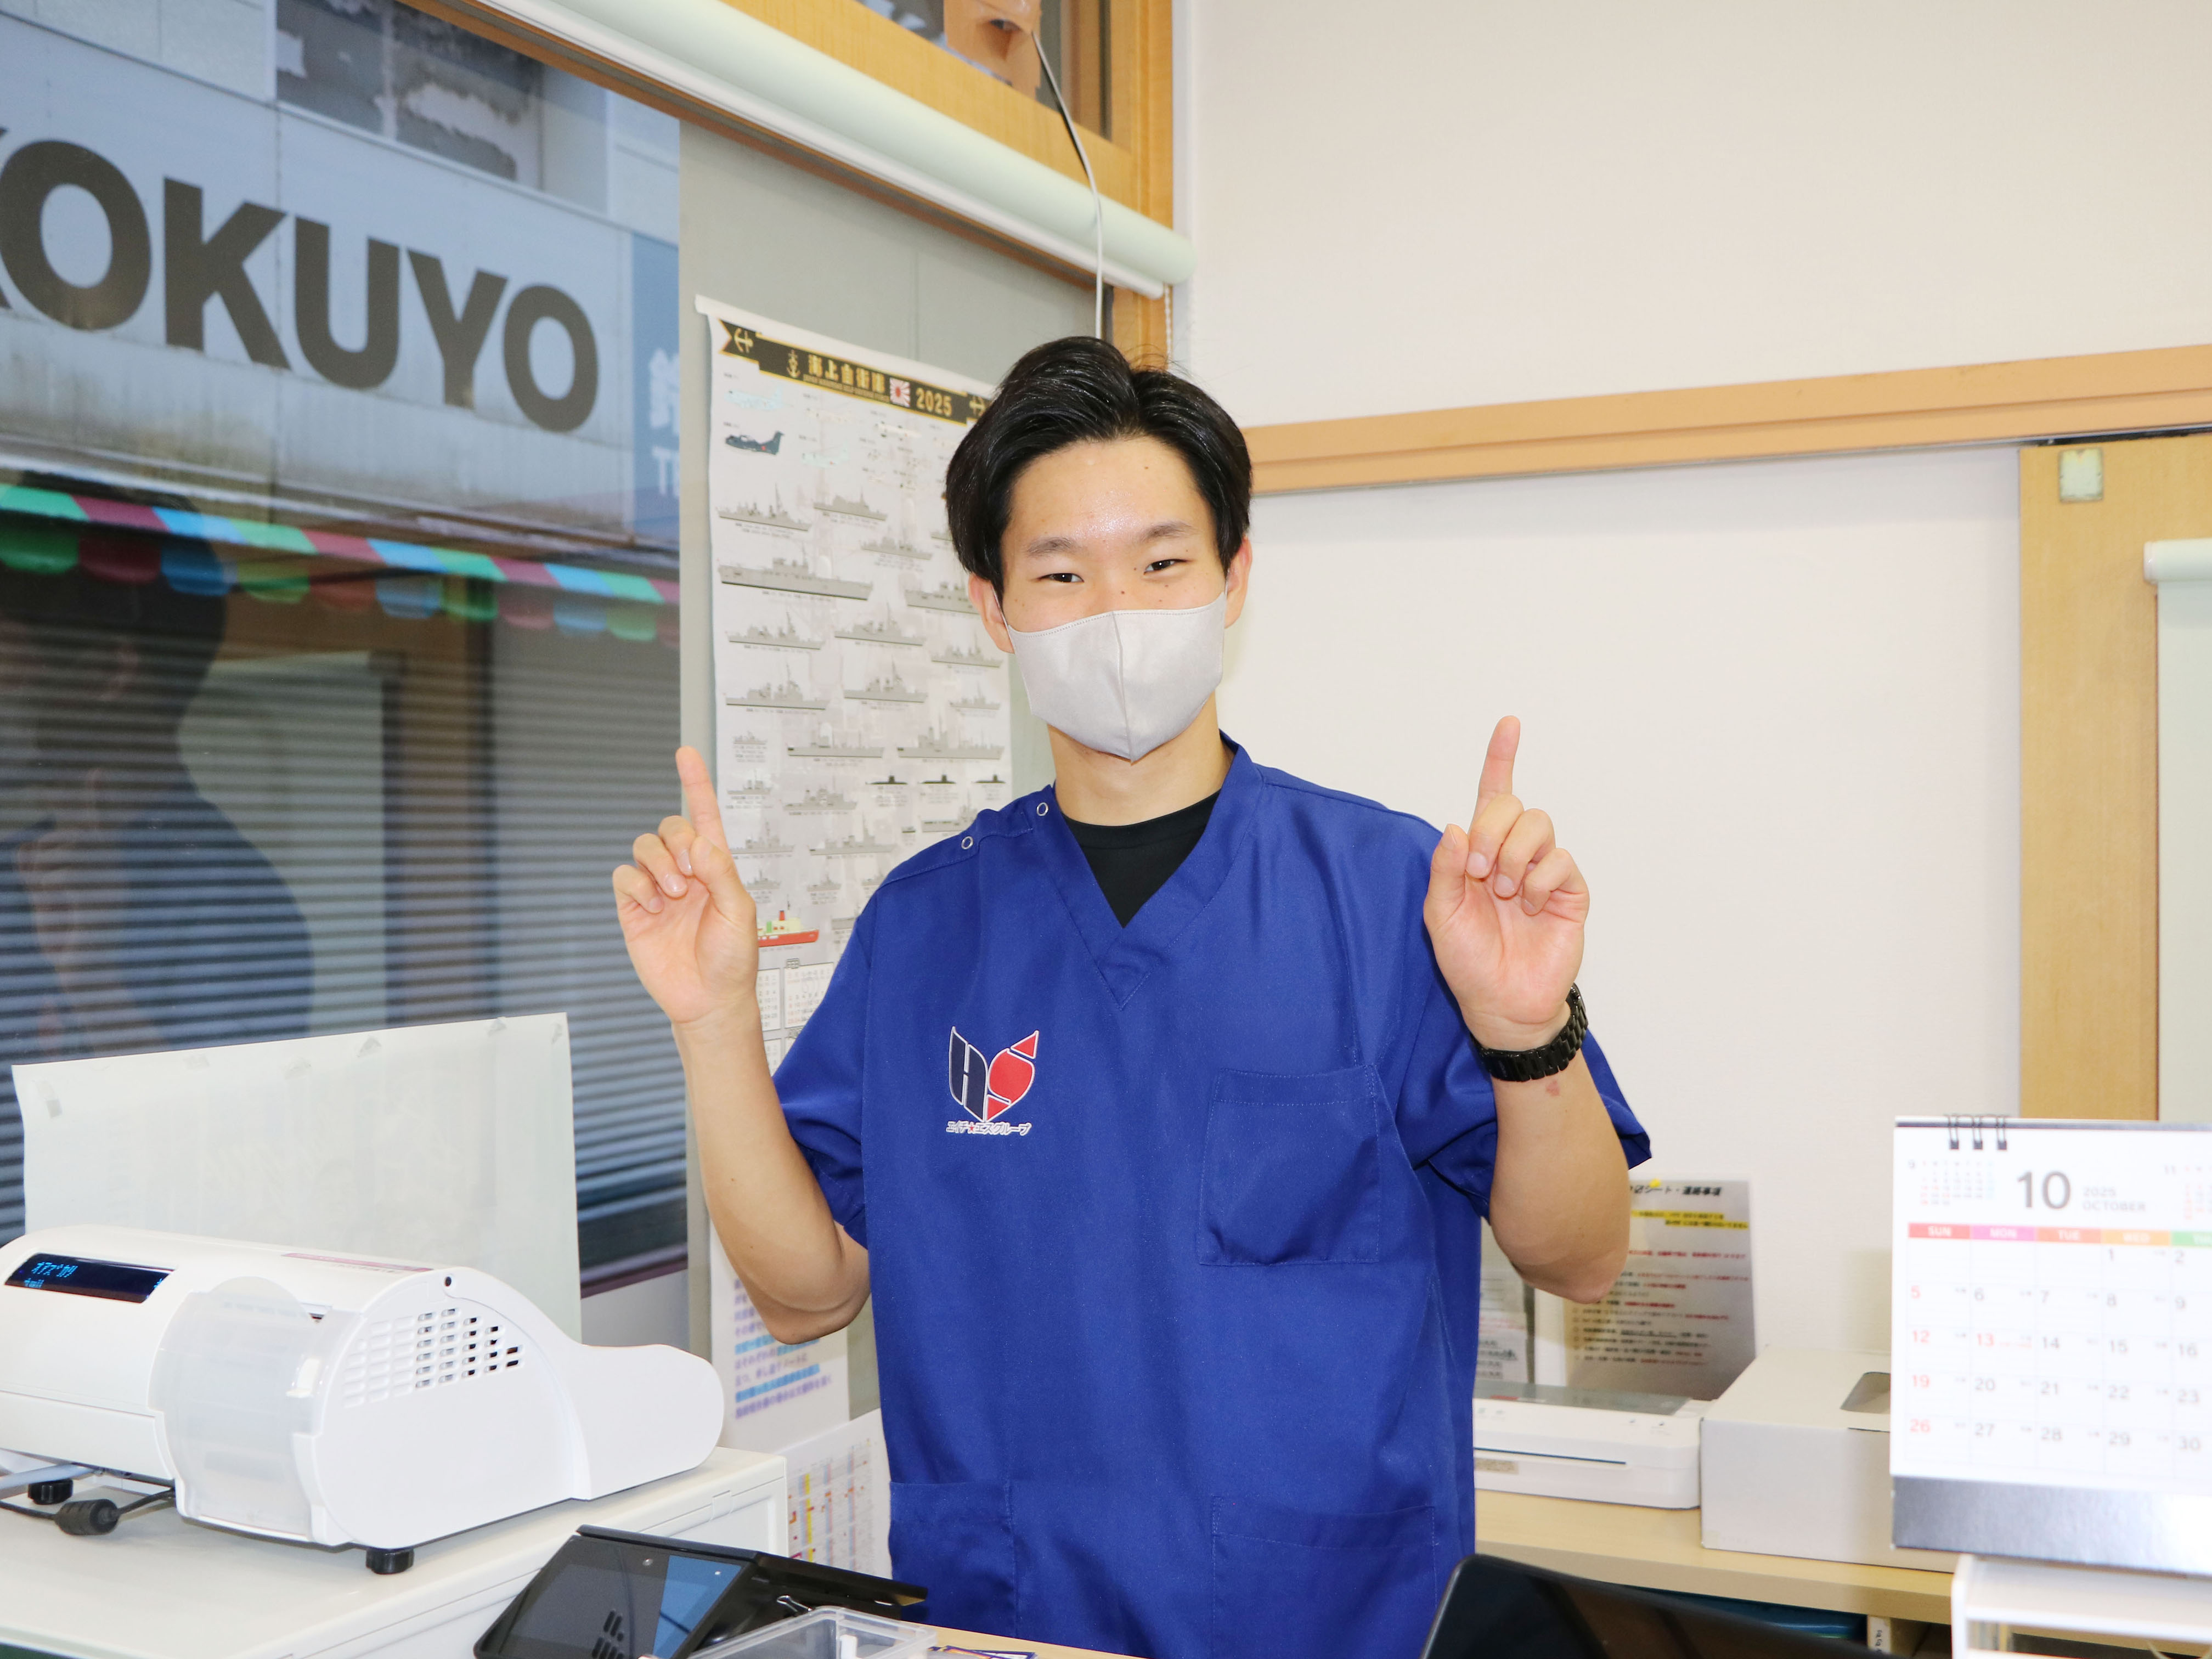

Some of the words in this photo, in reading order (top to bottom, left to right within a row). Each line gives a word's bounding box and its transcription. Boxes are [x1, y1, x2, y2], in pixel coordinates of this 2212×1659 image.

[0, 127, 599, 433] OKUYO
[916, 387, 952, 416] 2025
[2017, 1171, 2072, 1210] 10
[2084, 1187, 2116, 1197] 2025
[2083, 1200, 2146, 1211] OCTOBER
[1928, 1226, 1951, 1237] SUN
[1990, 1229, 2017, 1238] MON
[2058, 1230, 2081, 1241] TUE
[2124, 1234, 2149, 1243] WED
[2175, 1249, 2185, 1264] 2
[1911, 1285, 1921, 1299] 5
[1973, 1288, 1985, 1301] 6
[2041, 1290, 2050, 1304] 7
[2107, 1294, 2117, 1306] 8
[2175, 1297, 2186, 1310] 9
[1913, 1330, 1930, 1343] 12
[1977, 1333, 1994, 1346] 13
[2042, 1336, 2060, 1349] 14
[2110, 1340, 2128, 1353] 15
[2179, 1344, 2198, 1357] 16
[1912, 1375, 1930, 1387] 19
[1975, 1378, 1996, 1391] 20
[2040, 1381, 2058, 1395] 21
[2108, 1384, 2129, 1400] 22
[2178, 1390, 2199, 1403] 23
[1910, 1419, 1931, 1432] 26
[1975, 1423, 1995, 1436] 27
[2041, 1427, 2062, 1441] 28
[2109, 1432, 2130, 1445] 29
[2179, 1436, 2202, 1451] 30
